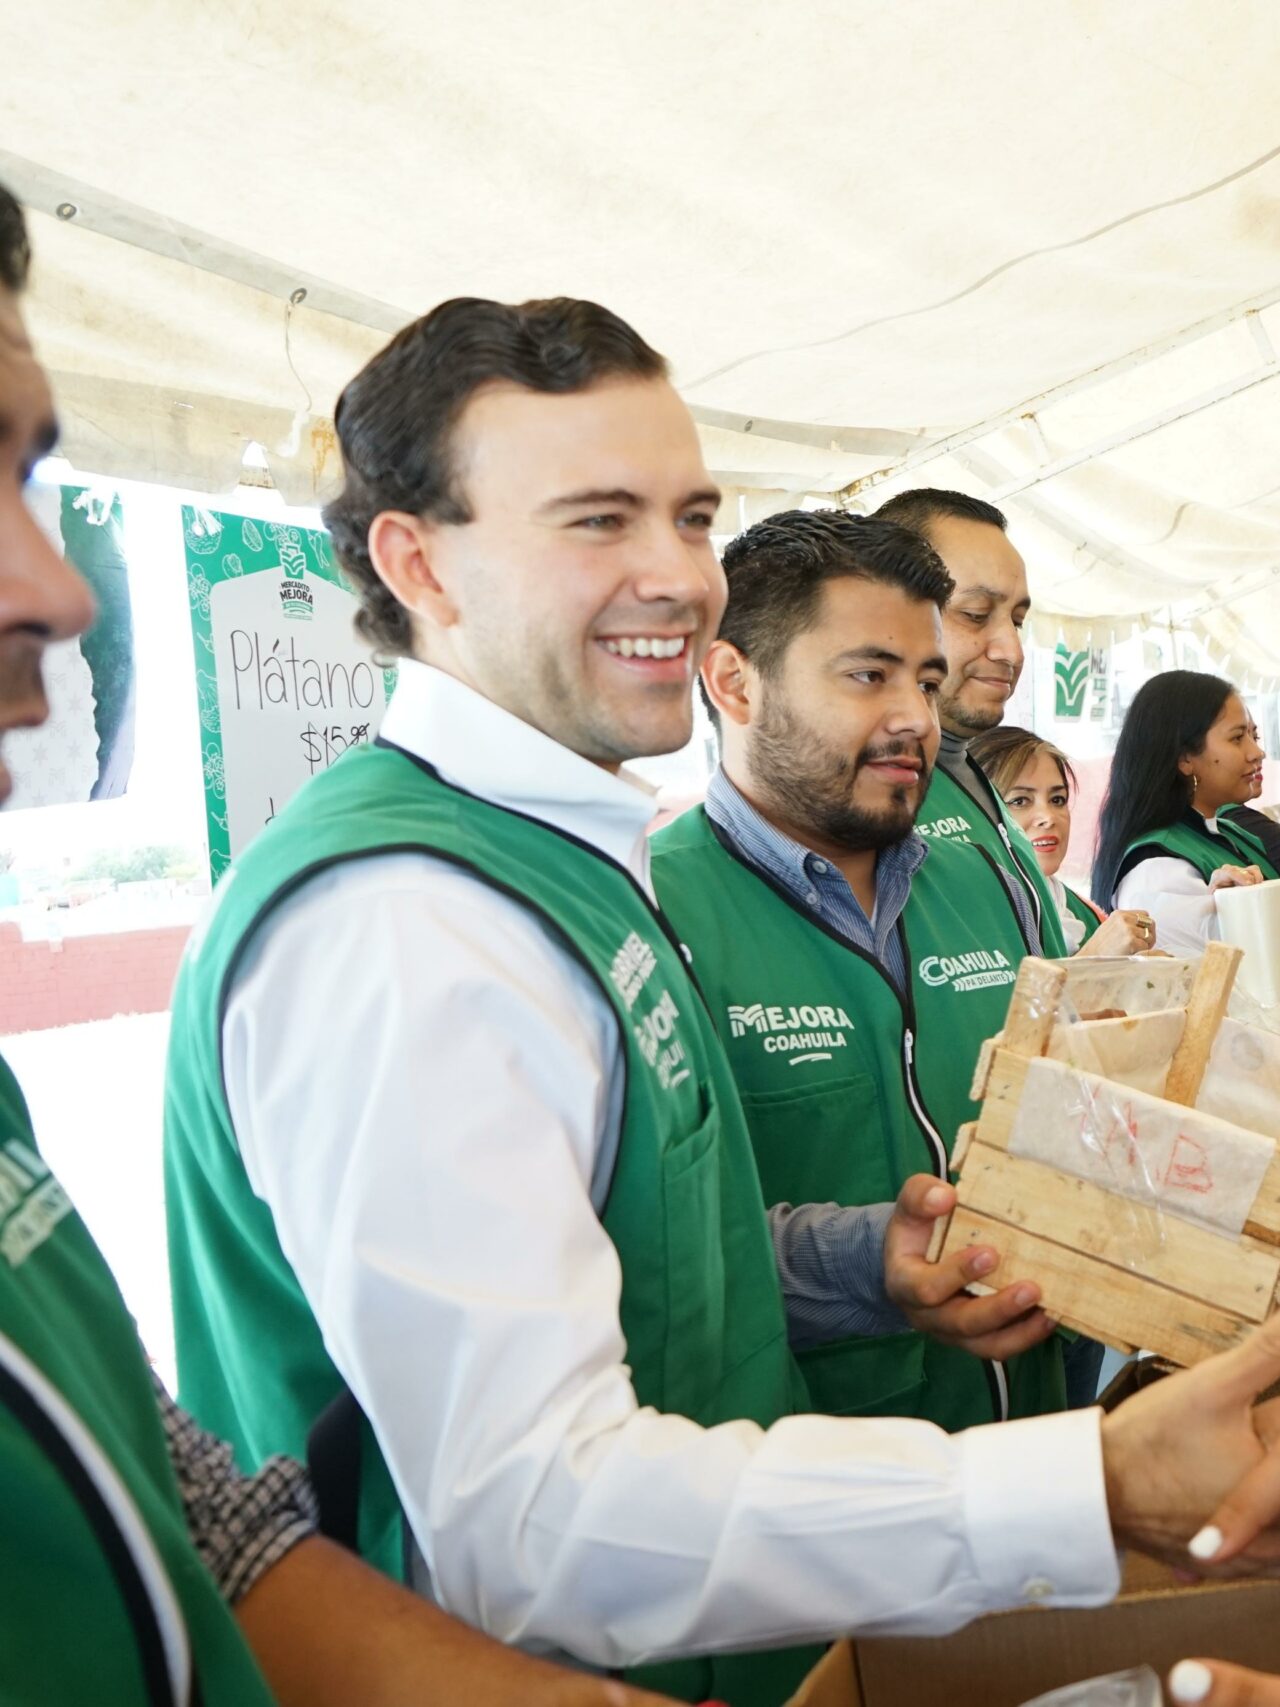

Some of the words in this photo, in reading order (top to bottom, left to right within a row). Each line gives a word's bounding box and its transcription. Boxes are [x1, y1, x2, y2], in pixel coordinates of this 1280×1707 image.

[280, 581, 310, 593] MERCADITO
[280, 589, 313, 605] MEJORA
[230, 629, 374, 710] Plátano
[919, 950, 1010, 986] COAHUILA
[727, 1003, 855, 1038] MEJORA
[763, 1031, 848, 1053] COAHUILA
